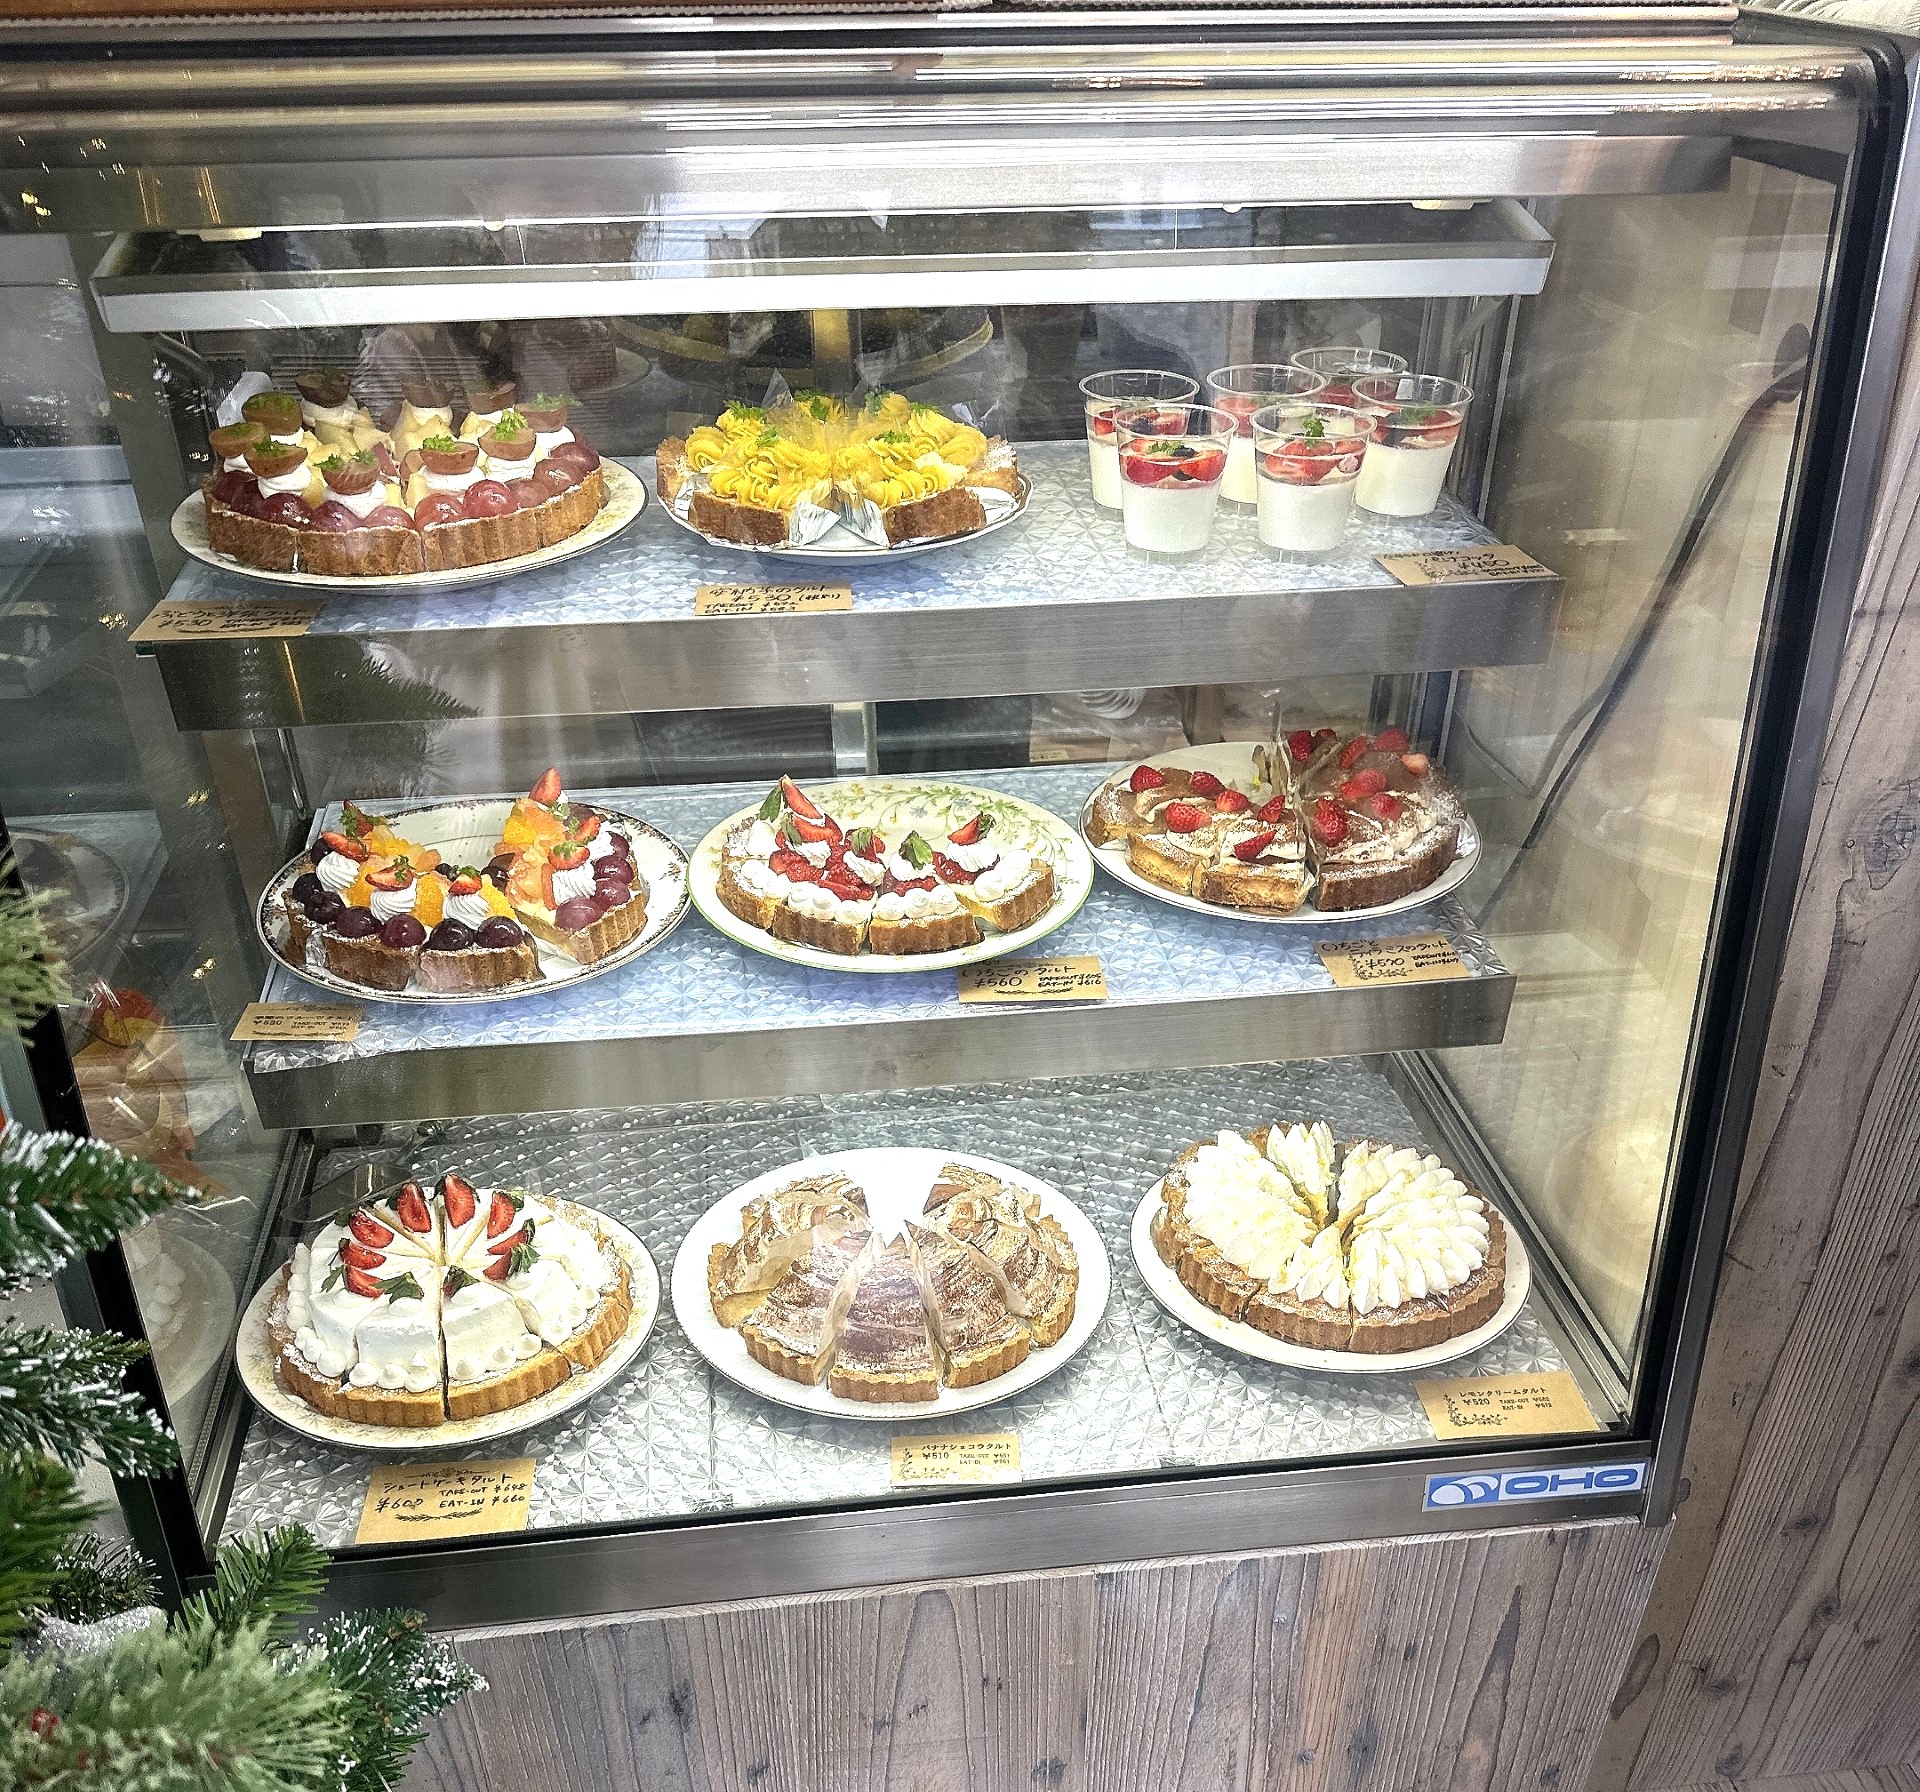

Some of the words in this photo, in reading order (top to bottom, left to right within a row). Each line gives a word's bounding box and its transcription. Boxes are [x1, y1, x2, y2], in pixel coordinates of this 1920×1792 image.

[731, 594, 792, 603] ¥530
[1321, 940, 1379, 951] いちごと
[1365, 957, 1405, 970] ¥570
[974, 977, 1023, 988] ¥560
[1459, 1387, 1548, 1397] レモンクリームタルト
[1464, 1398, 1490, 1406] ¥520
[921, 1443, 1011, 1451] バナナショコラタルト
[922, 1452, 949, 1460] ¥510
[383, 1474, 513, 1494] ショートケーキタルト
[1505, 1468, 1639, 1495] OHO
[439, 1487, 488, 1497] TAKE-OUT
[494, 1483, 527, 1493] ¥648
[375, 1497, 424, 1513] ¥600
[439, 1498, 485, 1509] EAT-IN
[491, 1495, 525, 1506] ¥660
